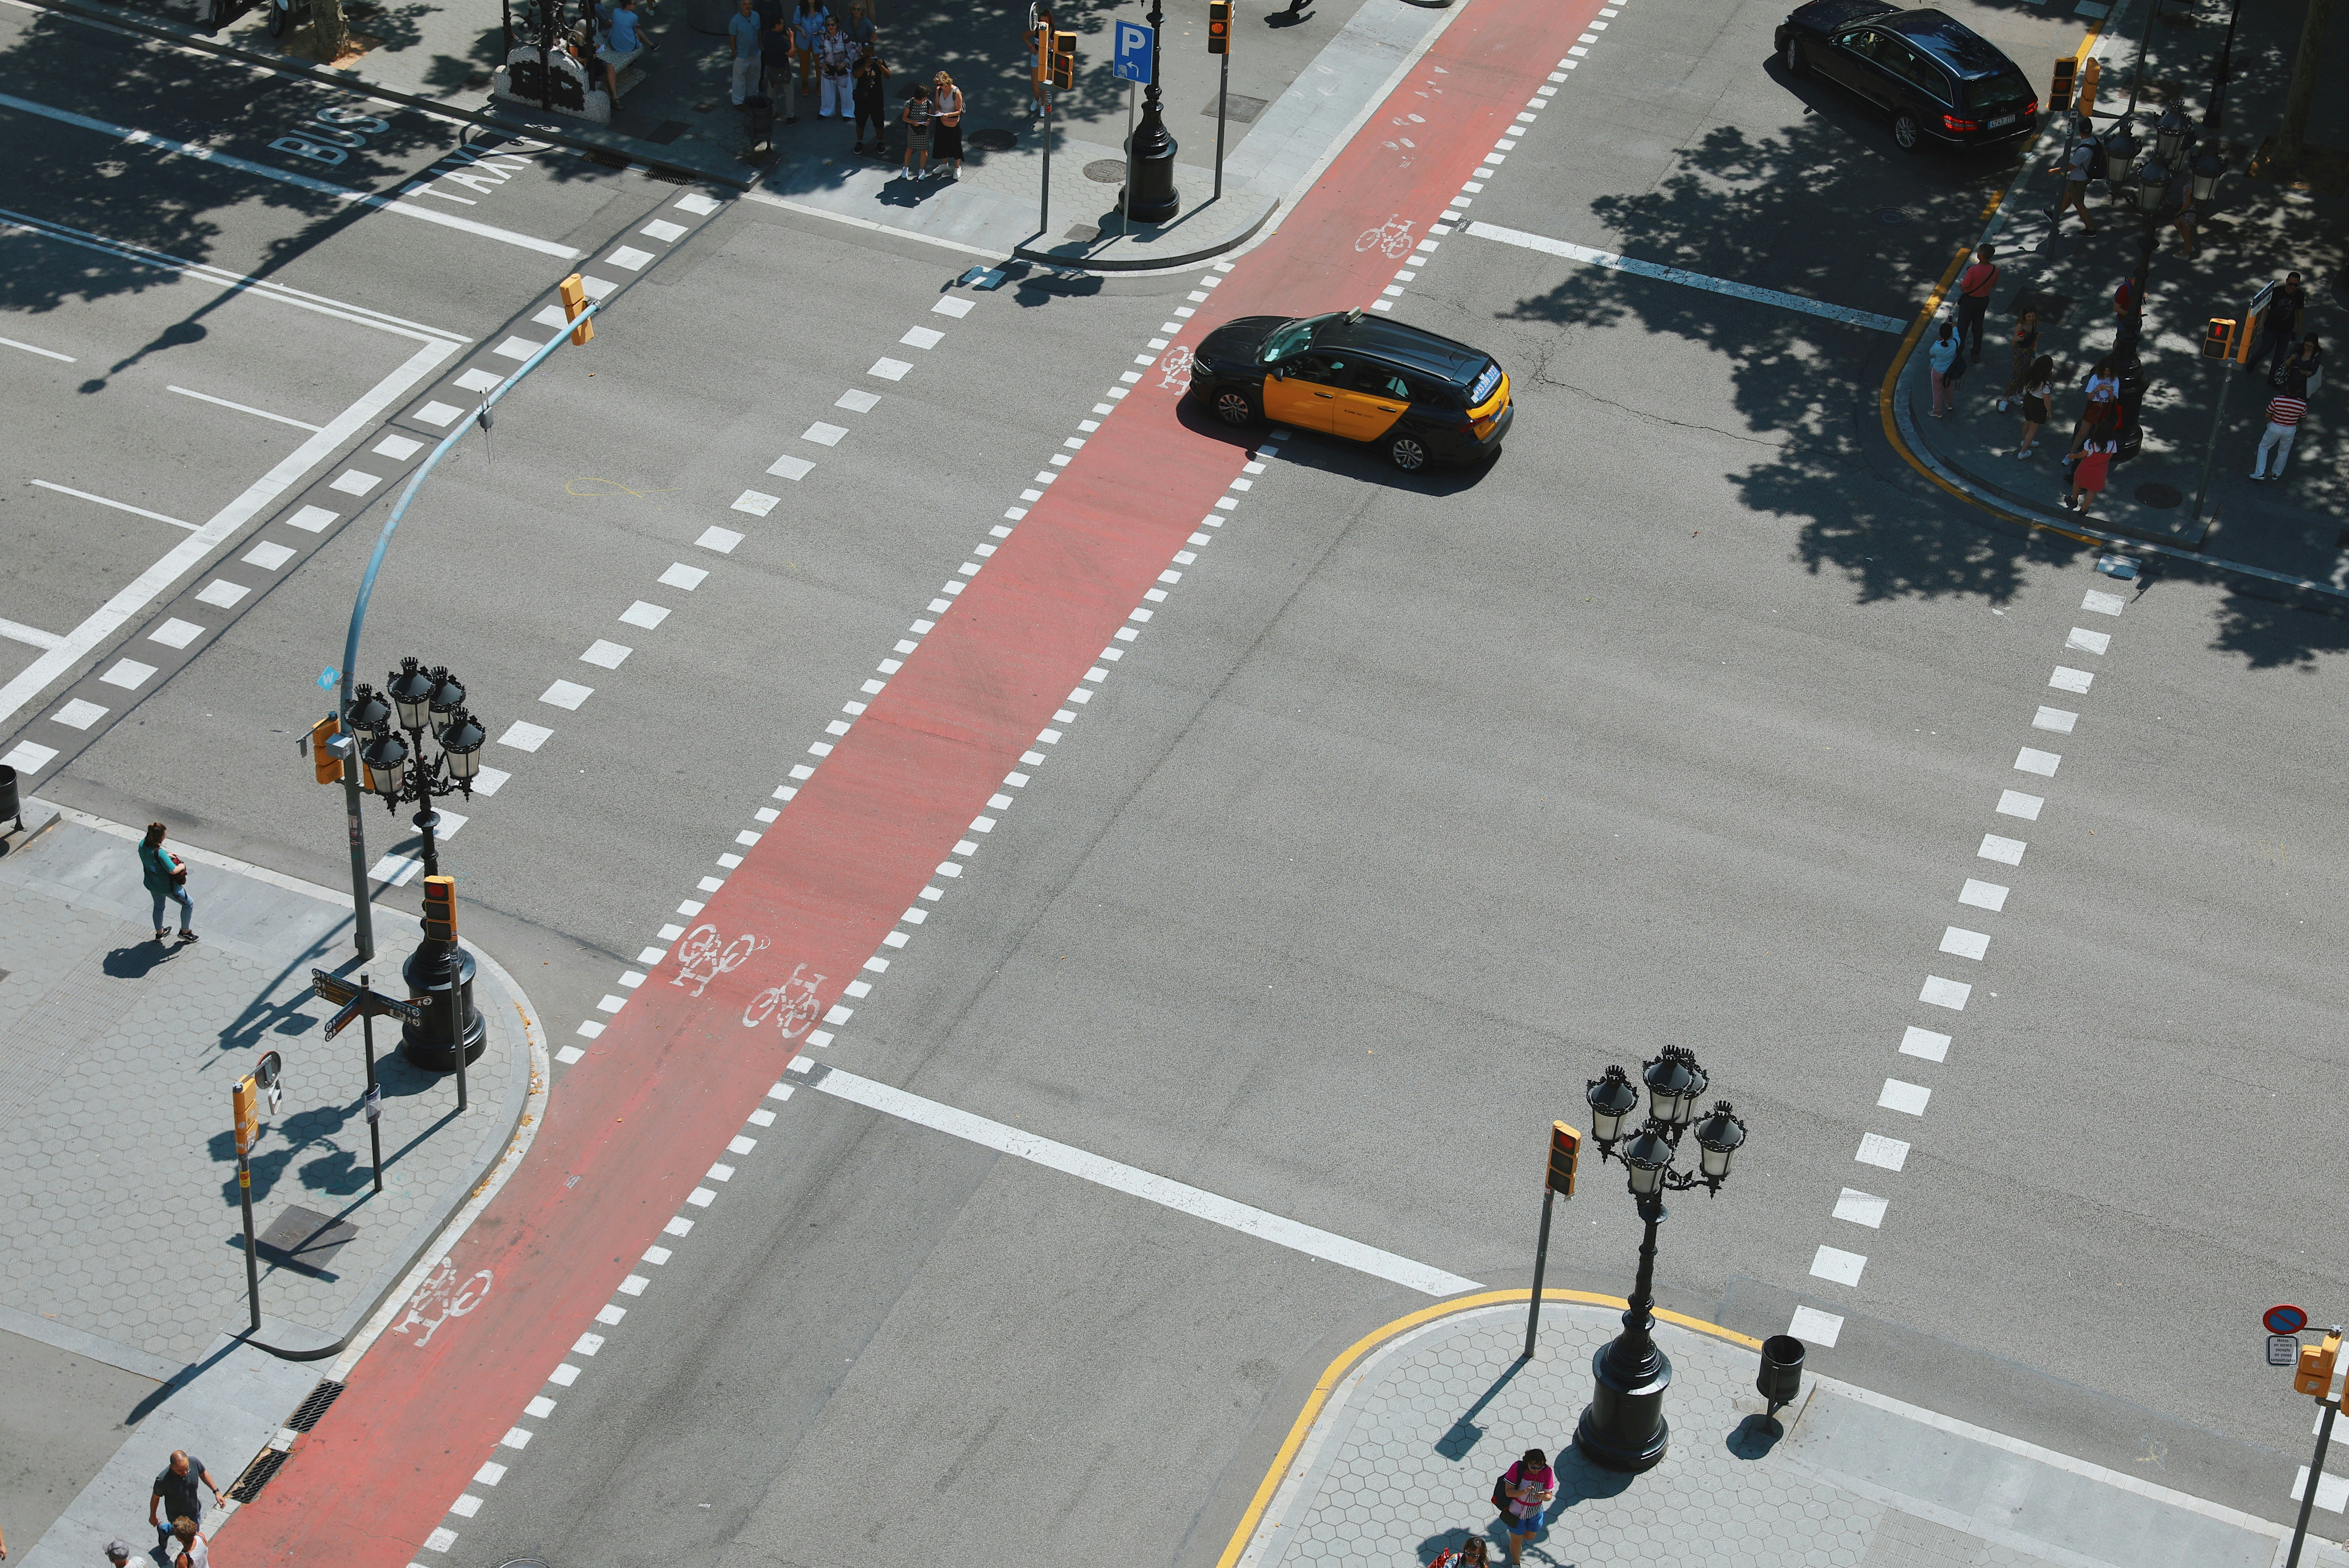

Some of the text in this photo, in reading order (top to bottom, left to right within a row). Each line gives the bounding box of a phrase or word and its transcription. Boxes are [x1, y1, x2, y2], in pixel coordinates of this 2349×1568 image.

[1122, 27, 1146, 57] P
[267, 107, 390, 165] BUS
[1991, 118, 2004, 127] 4743
[398, 143, 533, 205] TAXI
[1477, 365, 1498, 393] 93 399 3737
[322, 672, 334, 685] W
